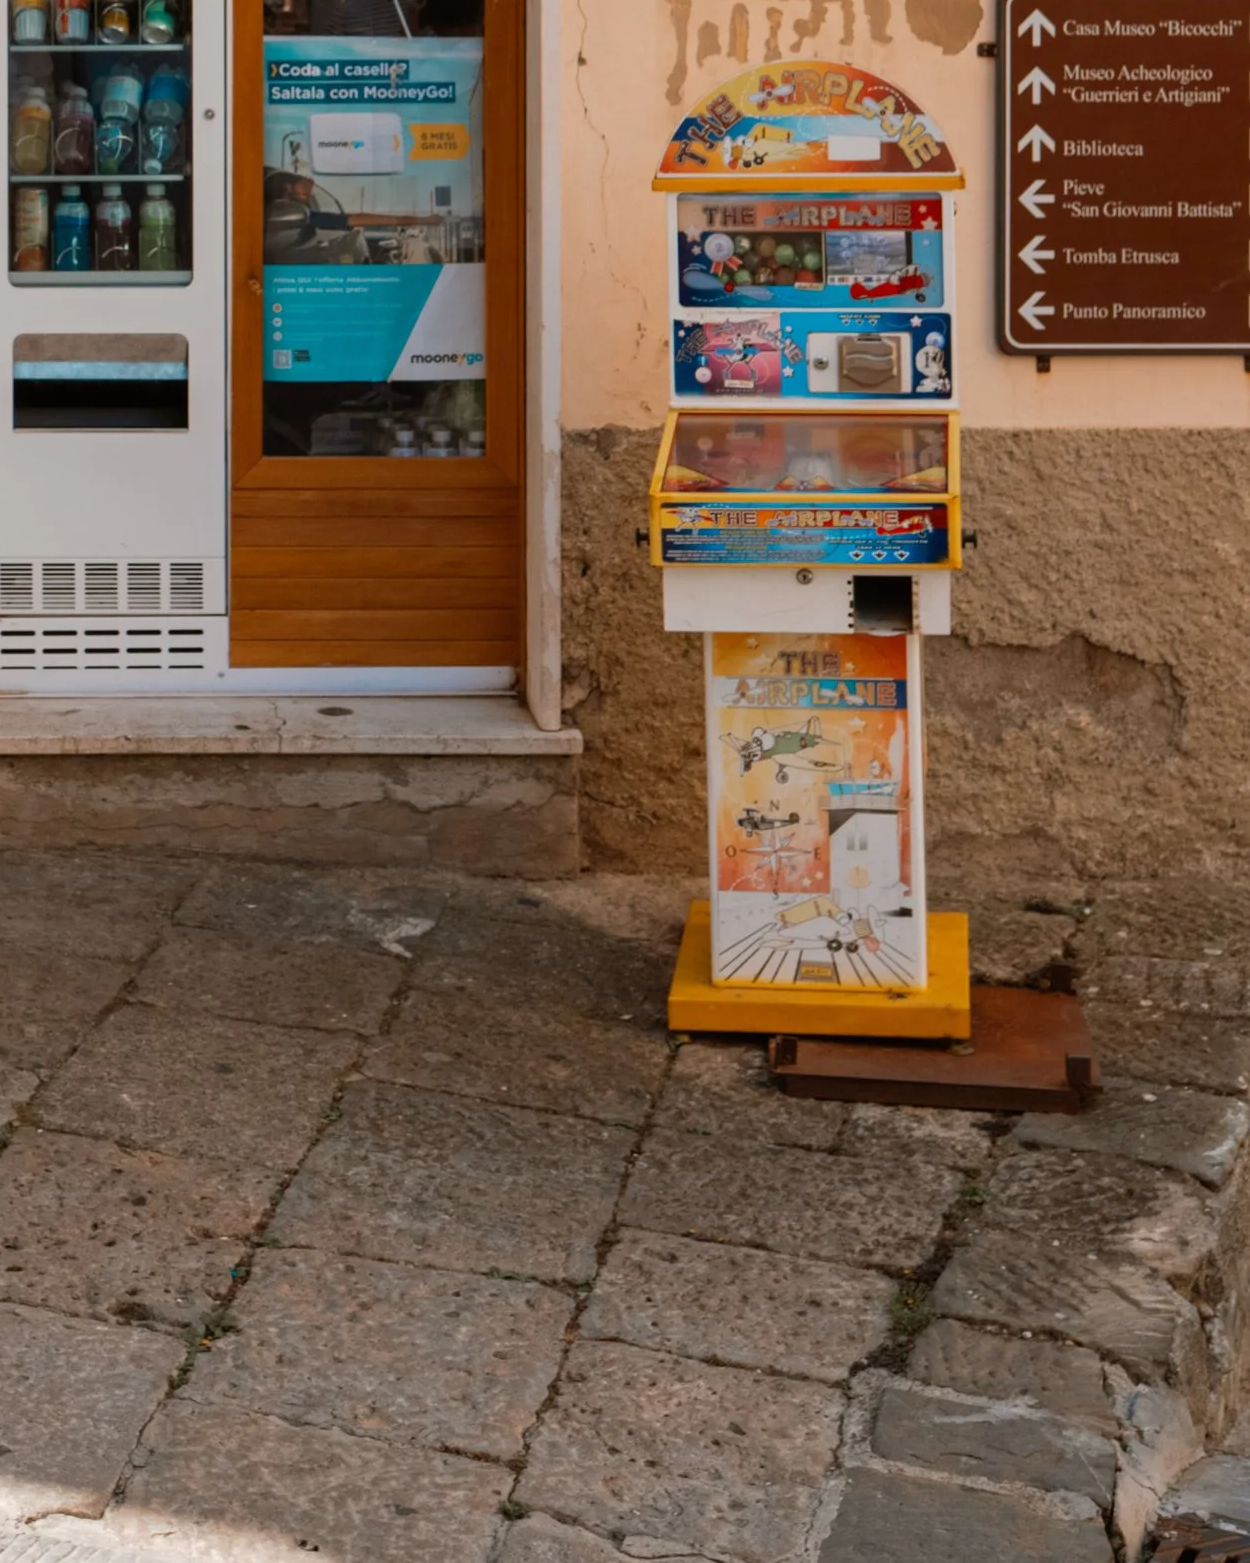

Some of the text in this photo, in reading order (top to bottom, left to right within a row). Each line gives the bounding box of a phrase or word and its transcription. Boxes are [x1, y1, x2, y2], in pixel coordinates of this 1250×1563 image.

[1062, 20, 1100, 37] Casa
[1104, 20, 1156, 37] Museo
[279, 63, 321, 77] Coda
[326, 63, 339, 77] al
[1062, 64, 1213, 85] Museo Acheologico
[271, 85, 453, 102] Saltala con MooneyGo!
[1143, 92, 1152, 103] e
[674, 69, 942, 169] THE AIRPLANE
[420, 133, 455, 141] 6 MESI
[420, 142, 458, 151] GRATIS
[1062, 140, 1144, 157] Biblioteca
[1062, 180, 1105, 196] Pieve
[702, 204, 912, 228] THE AIRPLANE
[1103, 201, 1173, 218] Giovanni
[1062, 248, 1180, 264] Tomba Etrusca
[1062, 302, 1206, 319] Punto Panoramico
[675, 328, 708, 363] THE
[410, 350, 484, 366] mooneygo
[709, 510, 899, 527] THE AIRPLANE
[778, 650, 843, 676] THE
[730, 680, 897, 706] AIRPLANE
[769, 800, 780, 812] N
[813, 847, 822, 861] E
